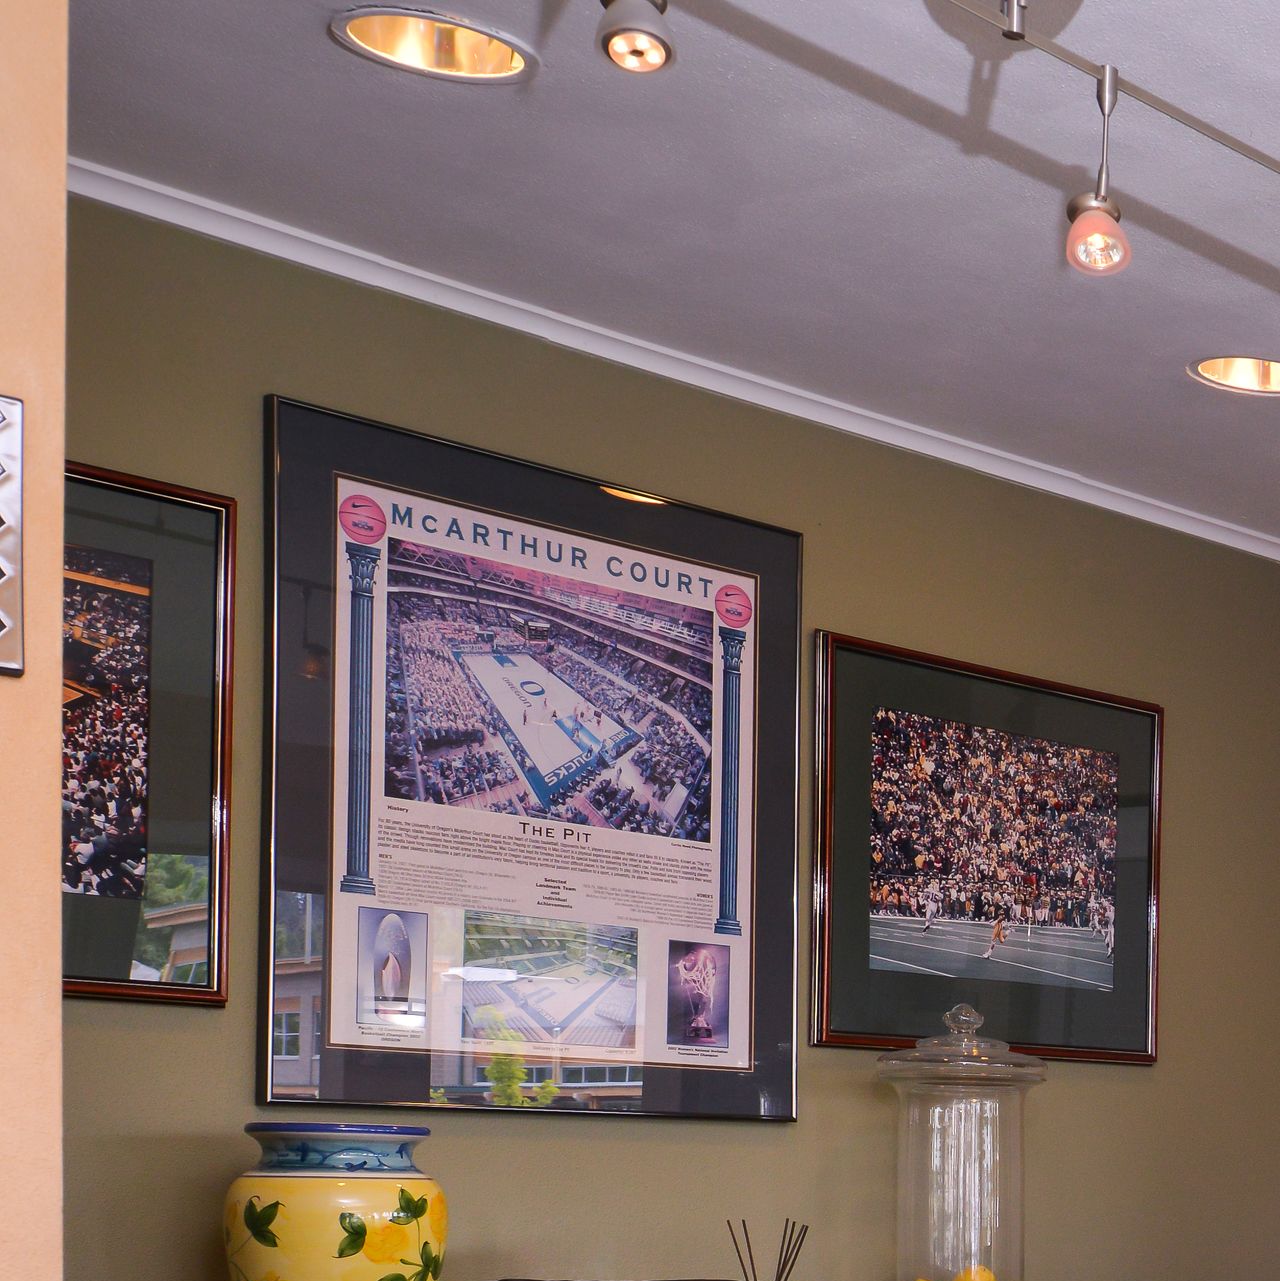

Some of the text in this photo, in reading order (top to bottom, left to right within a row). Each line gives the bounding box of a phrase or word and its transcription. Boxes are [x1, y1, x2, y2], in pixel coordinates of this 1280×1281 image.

[606, 556, 713, 598] COURT
[502, 677, 532, 708] OREGON
[543, 752, 593, 786] DUCKS
[519, 821, 591, 843] THE PIT
